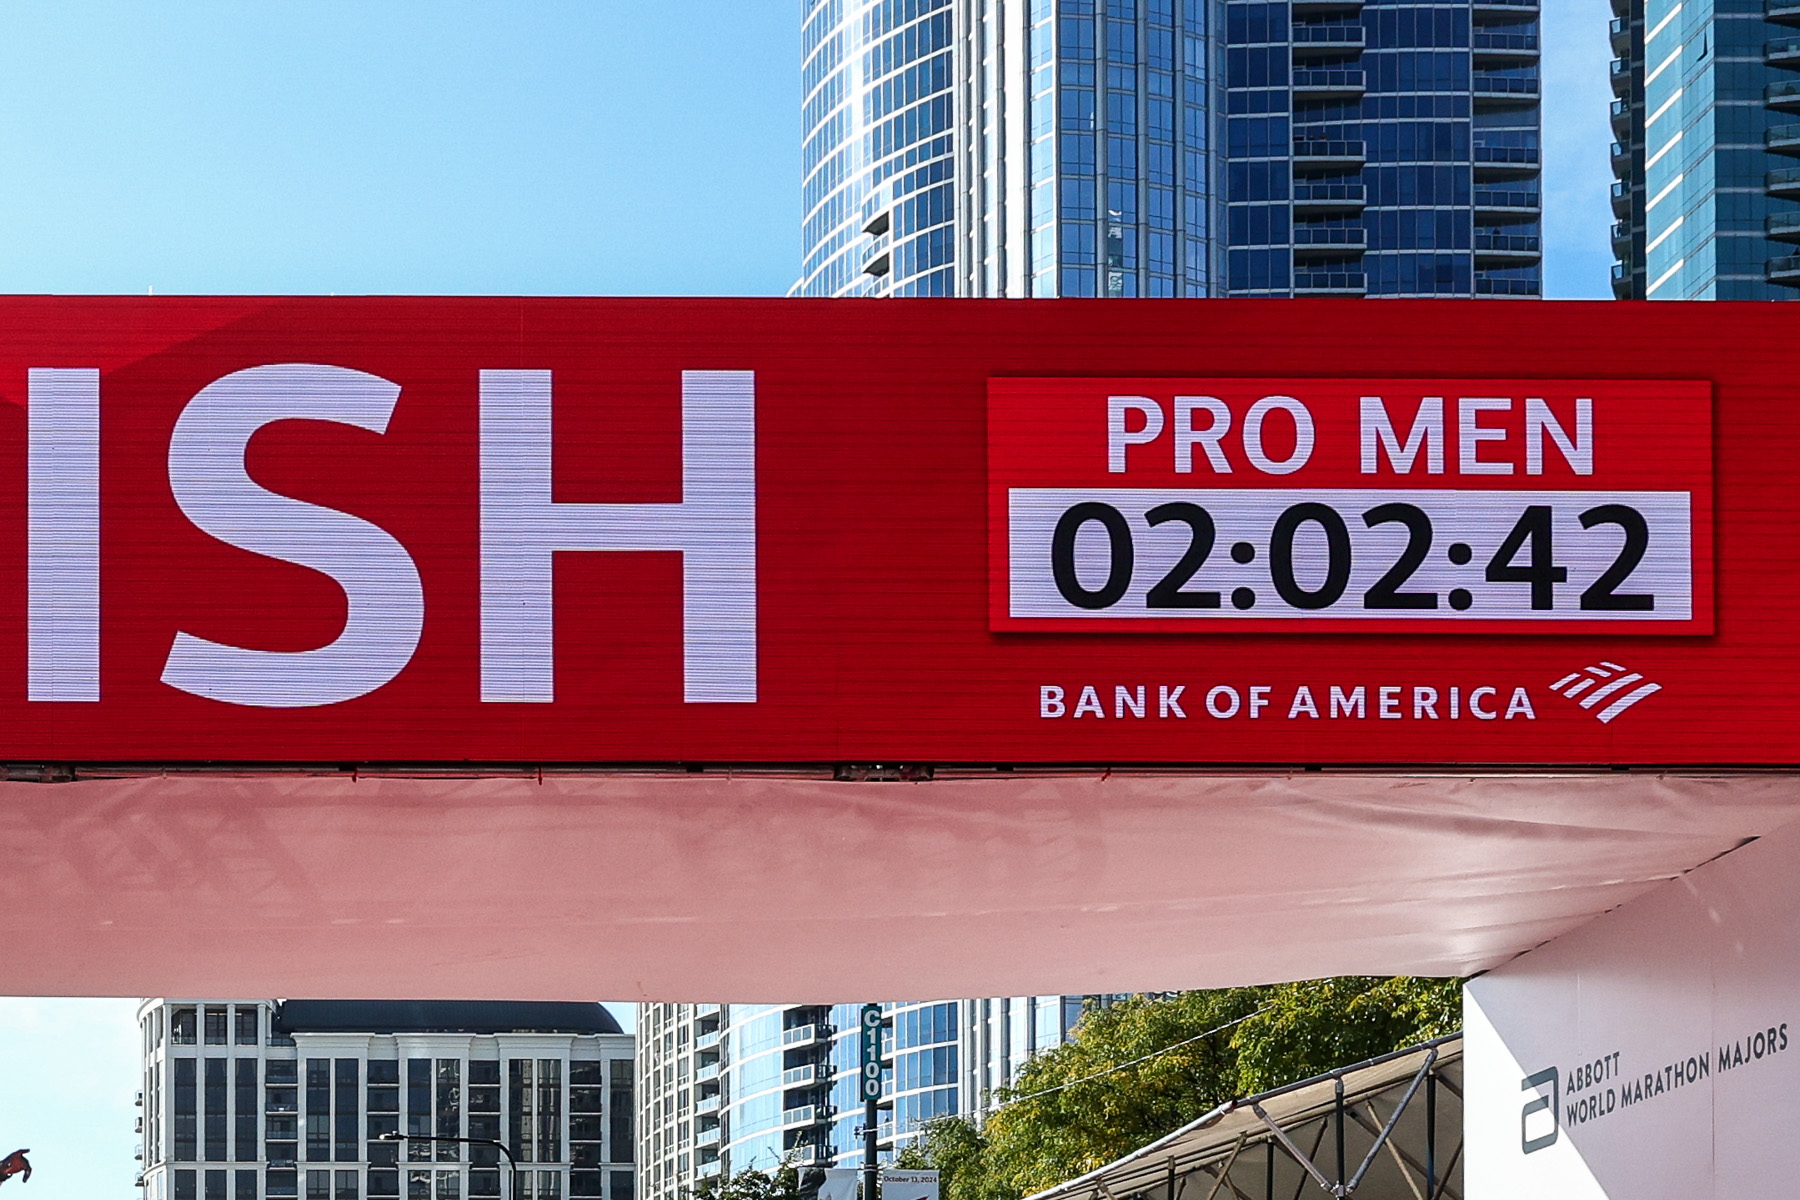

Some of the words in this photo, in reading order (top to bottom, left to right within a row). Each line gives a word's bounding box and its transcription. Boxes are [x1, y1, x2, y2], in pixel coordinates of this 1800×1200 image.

[1107, 395, 1316, 475] PRO
[1358, 396, 1595, 476] MEN
[1050, 501, 1655, 612] 02:02:42
[1039, 684, 1188, 719] BANK
[1205, 684, 1272, 719] OF
[1287, 685, 1537, 721] AMERICA
[863, 1010, 881, 1096] C1100
[1566, 1051, 1620, 1096] ABBOTT
[1566, 1088, 1616, 1128] WORLD
[1620, 1051, 1710, 1109] MARATHON
[1717, 1022, 1789, 1073] MAJORS
[883, 1175, 909, 1183] October
[919, 1175, 938, 1183] 2024
